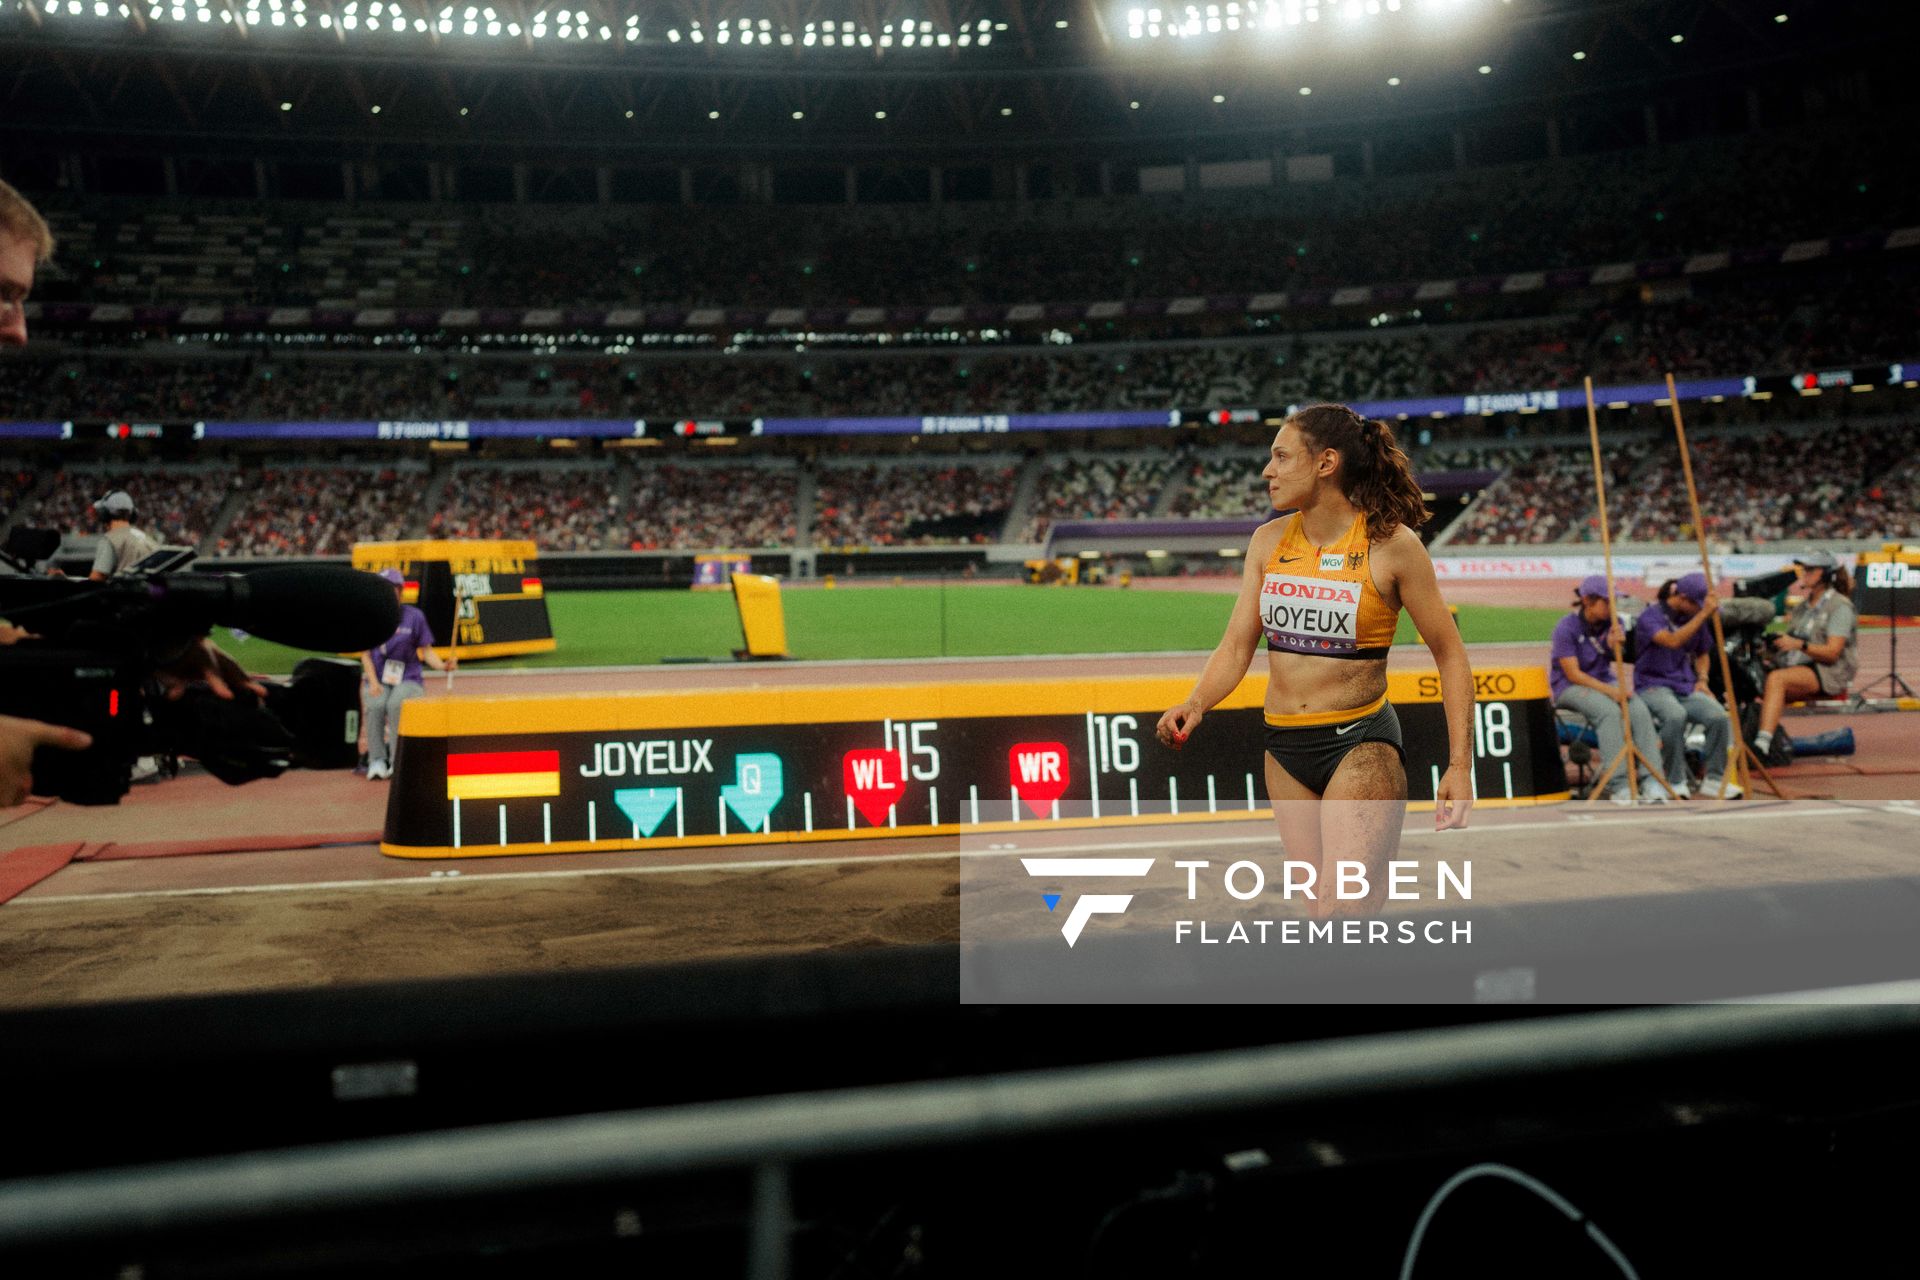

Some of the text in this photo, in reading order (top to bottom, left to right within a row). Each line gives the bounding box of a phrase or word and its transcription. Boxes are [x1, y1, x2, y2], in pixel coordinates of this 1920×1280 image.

[1263, 581, 1357, 604] HONDA
[1264, 604, 1350, 635] JOYEUX
[1418, 673, 1516, 698] SKO
[1093, 714, 1141, 773] 16
[1474, 702, 1513, 759] 18
[579, 738, 714, 778] JOYEUX
[892, 721, 941, 782] 15
[1017, 751, 1062, 783] WR
[742, 763, 762, 795] Q
[851, 758, 896, 790] WL
